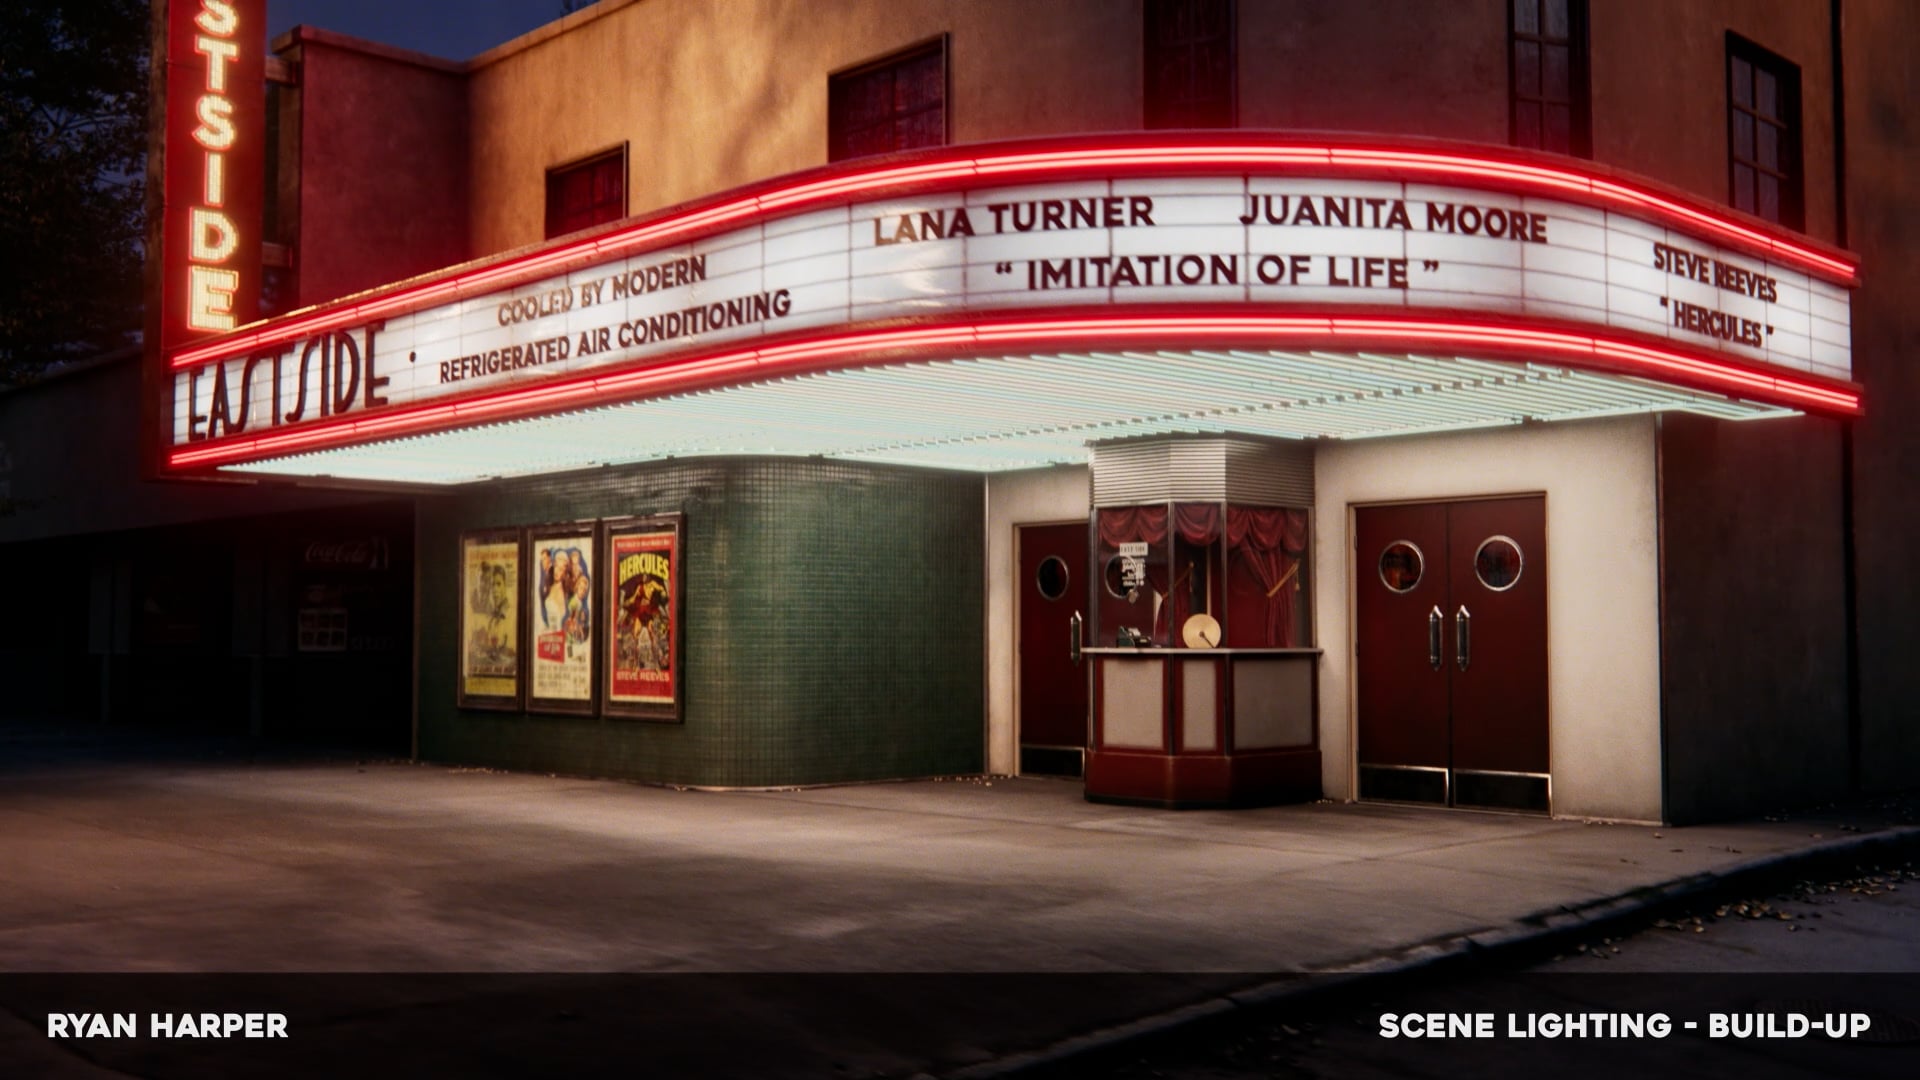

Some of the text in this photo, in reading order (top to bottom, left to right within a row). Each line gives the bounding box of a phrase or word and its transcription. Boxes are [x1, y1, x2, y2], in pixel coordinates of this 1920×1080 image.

[874, 196, 1156, 246] LANA TURNER
[1239, 194, 1548, 244] JUANITA MOORE
[498, 254, 707, 327] COOLED BY MODERN
[1256, 254, 1311, 286] OF
[1653, 242, 1778, 304] STEVE REEVES
[439, 288, 792, 384] REFRIGERATED AIR CONDITIONING
[187, 320, 390, 442] EASTSIDE
[619, 552, 670, 586] HERCULES
